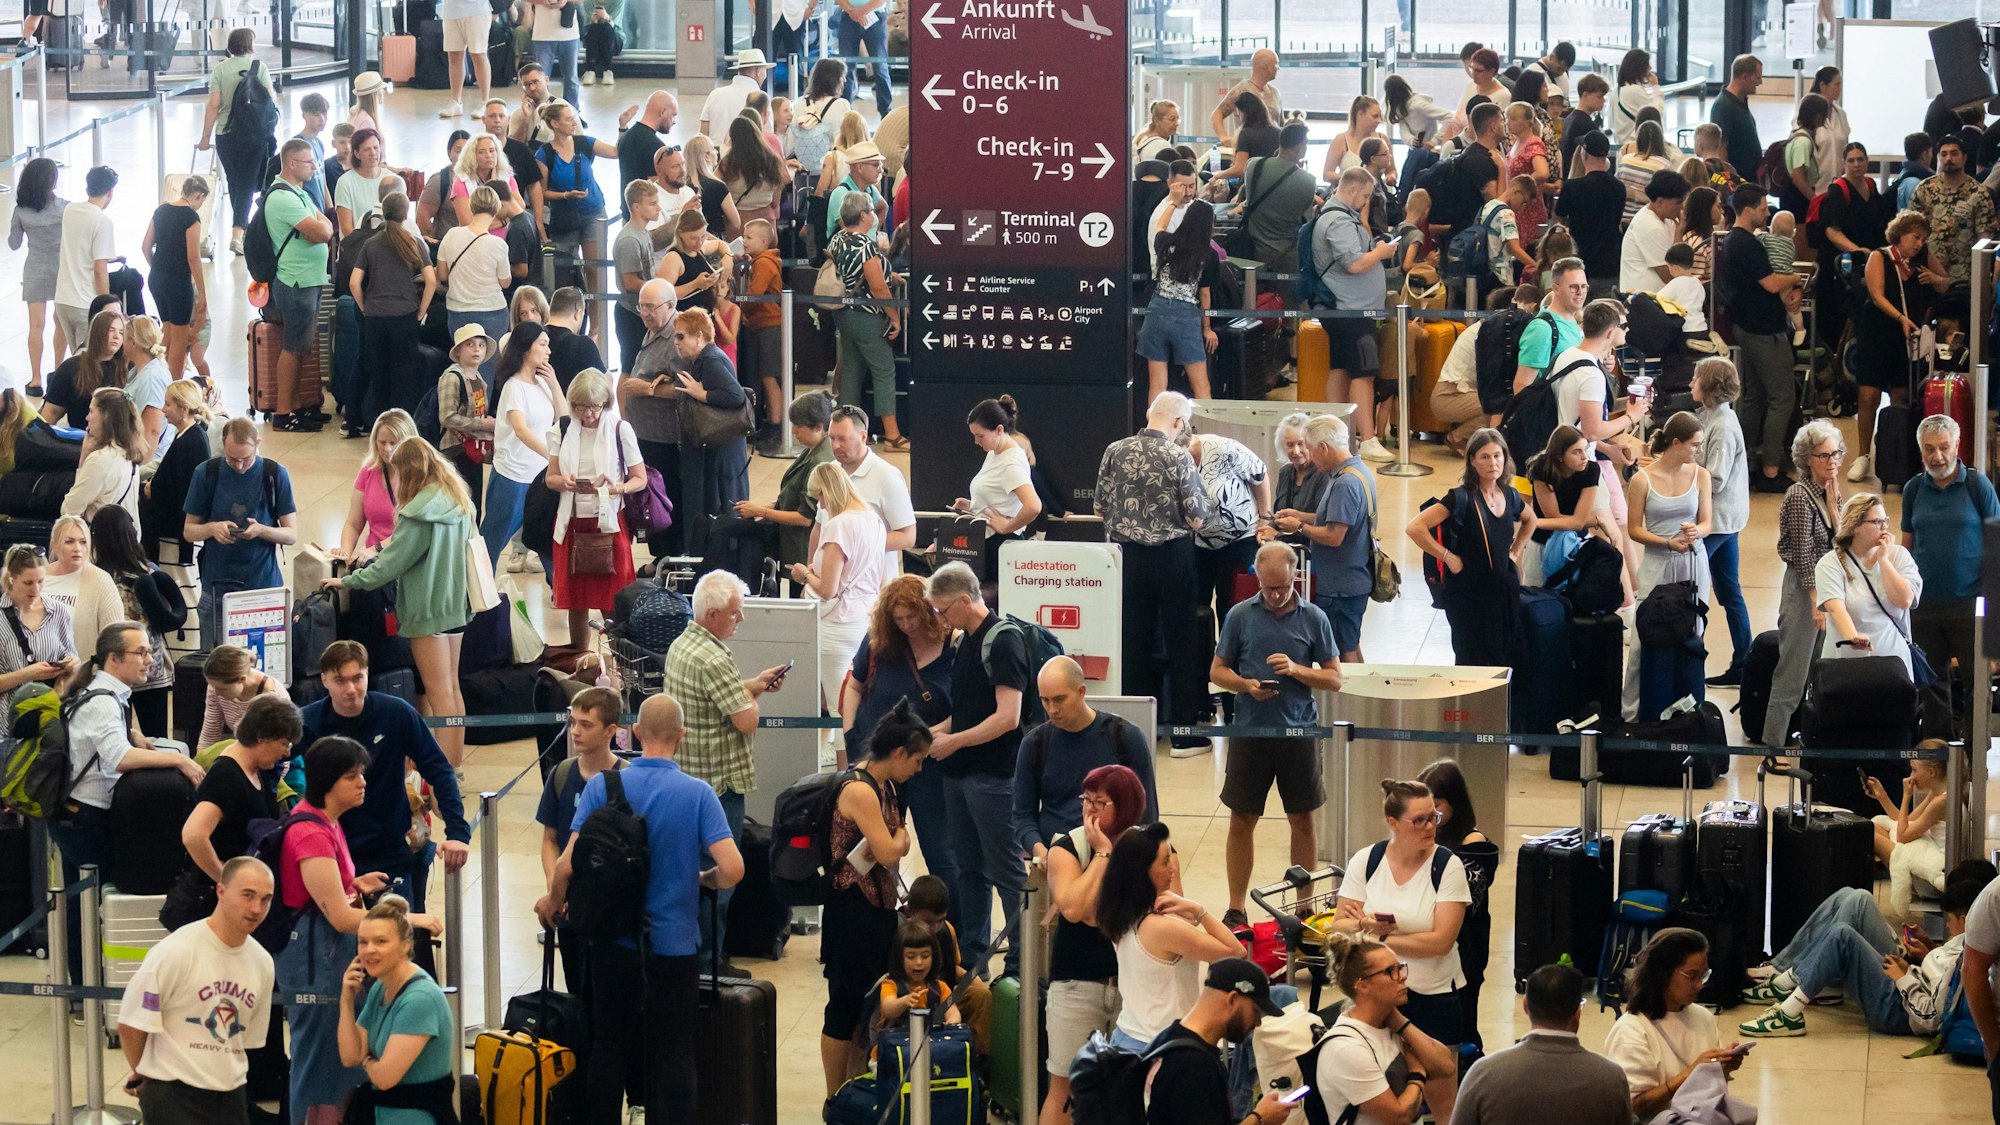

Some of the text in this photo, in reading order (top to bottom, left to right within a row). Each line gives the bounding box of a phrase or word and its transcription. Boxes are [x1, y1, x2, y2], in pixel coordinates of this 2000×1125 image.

[962, 0, 1055, 18] Ankunft
[962, 24, 1016, 40] Arrival
[962, 70, 1059, 90] Check-in
[977, 137, 1074, 156] Check-in
[1001, 211, 1075, 227] Terminal
[1084, 222, 1108, 238] T2
[1016, 232, 1056, 244] 500 m
[1075, 307, 1102, 315] Airport
[1075, 316, 1090, 324] City
[1074, 489, 1094, 498] BER
[942, 547, 977, 556] Heinemann
[1014, 560, 1076, 571] Ladestation
[1014, 576, 1102, 588] Charging station
[446, 717, 463, 725] BER
[1443, 710, 1469, 722] BER
[1173, 727, 1190, 735] BER
[1286, 728, 1303, 736] BER
[1477, 735, 1494, 743] BER
[1671, 743, 1688, 751] BER
[1900, 751, 1918, 759] BER
[34, 985, 54, 995] BER
[296, 994, 316, 1004] BER
